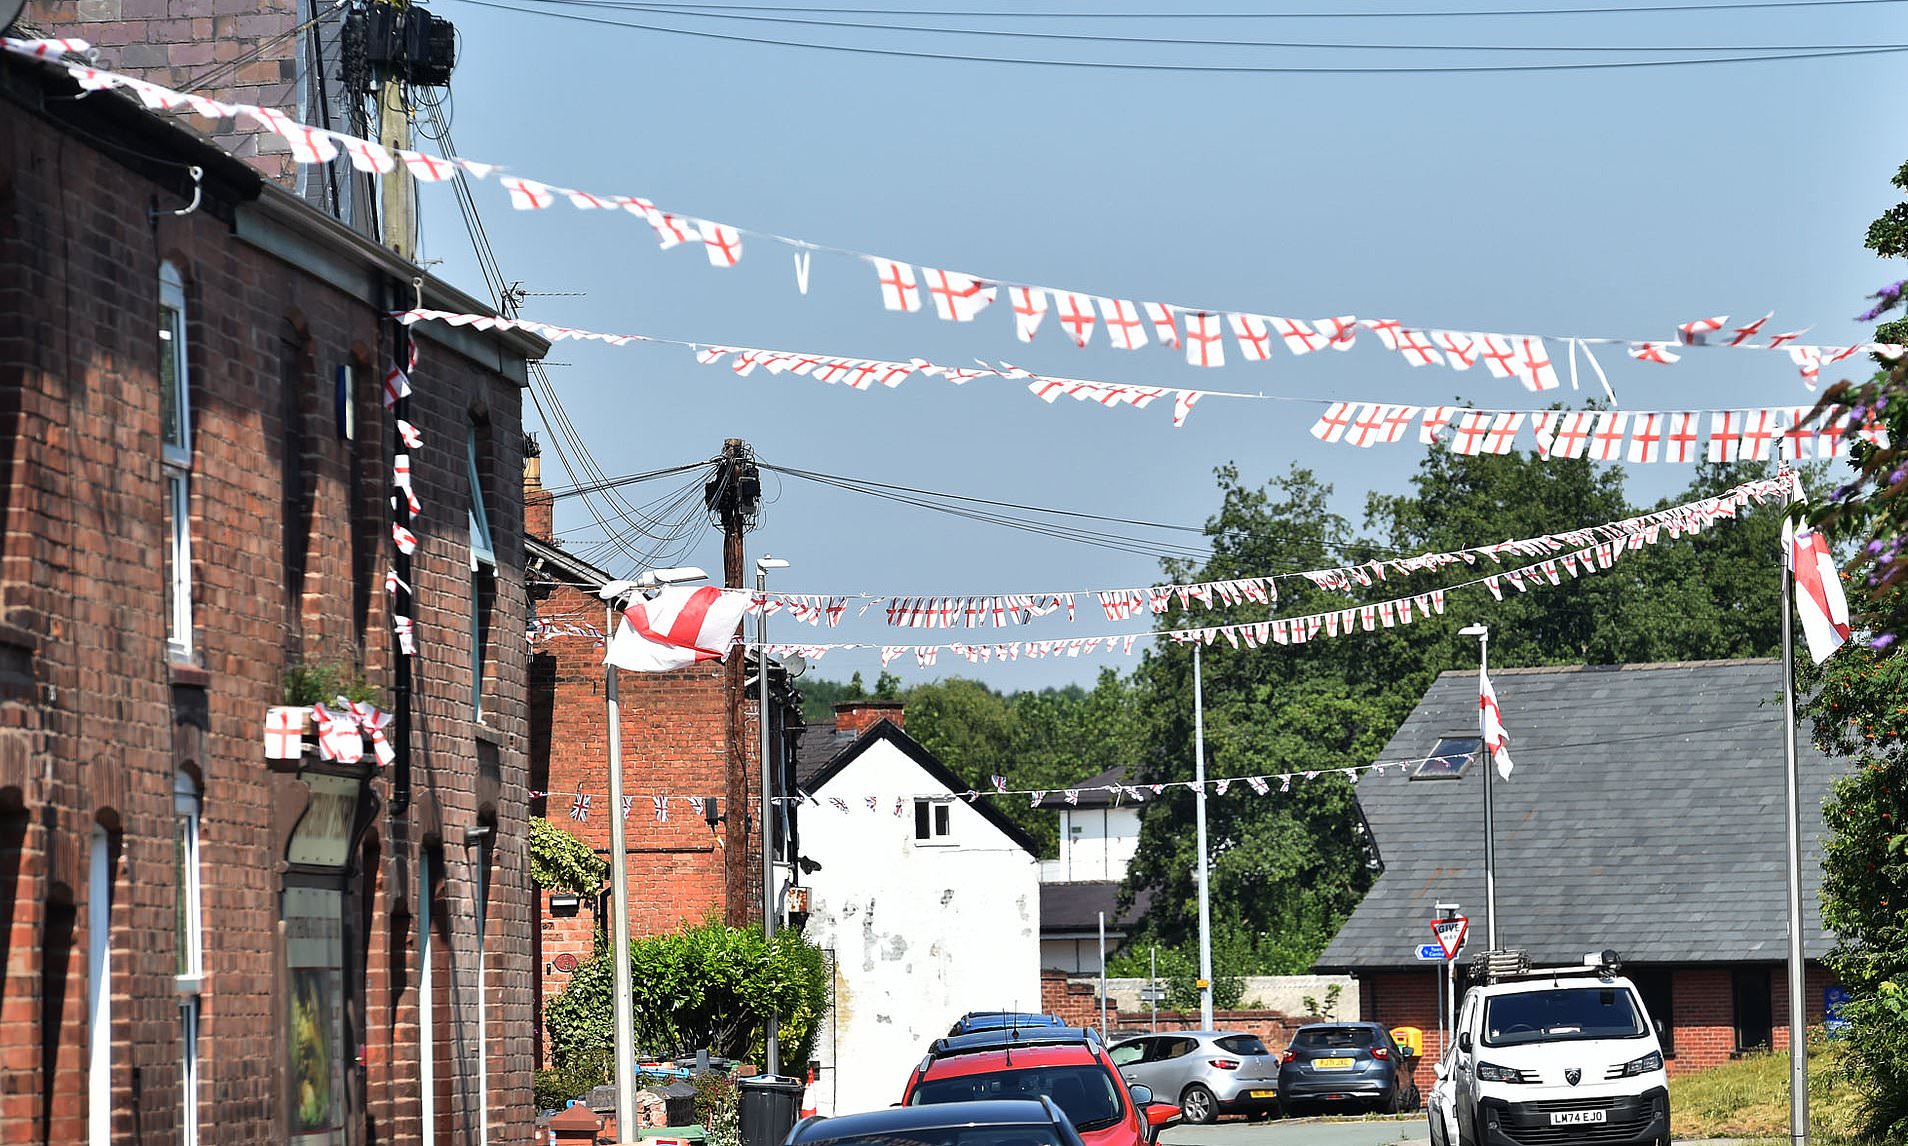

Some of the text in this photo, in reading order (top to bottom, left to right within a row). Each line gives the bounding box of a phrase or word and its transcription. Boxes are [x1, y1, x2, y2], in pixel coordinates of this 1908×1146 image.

[1438, 923, 1460, 933] GIVE
[1555, 1112, 1602, 1123] LM74 EJO
